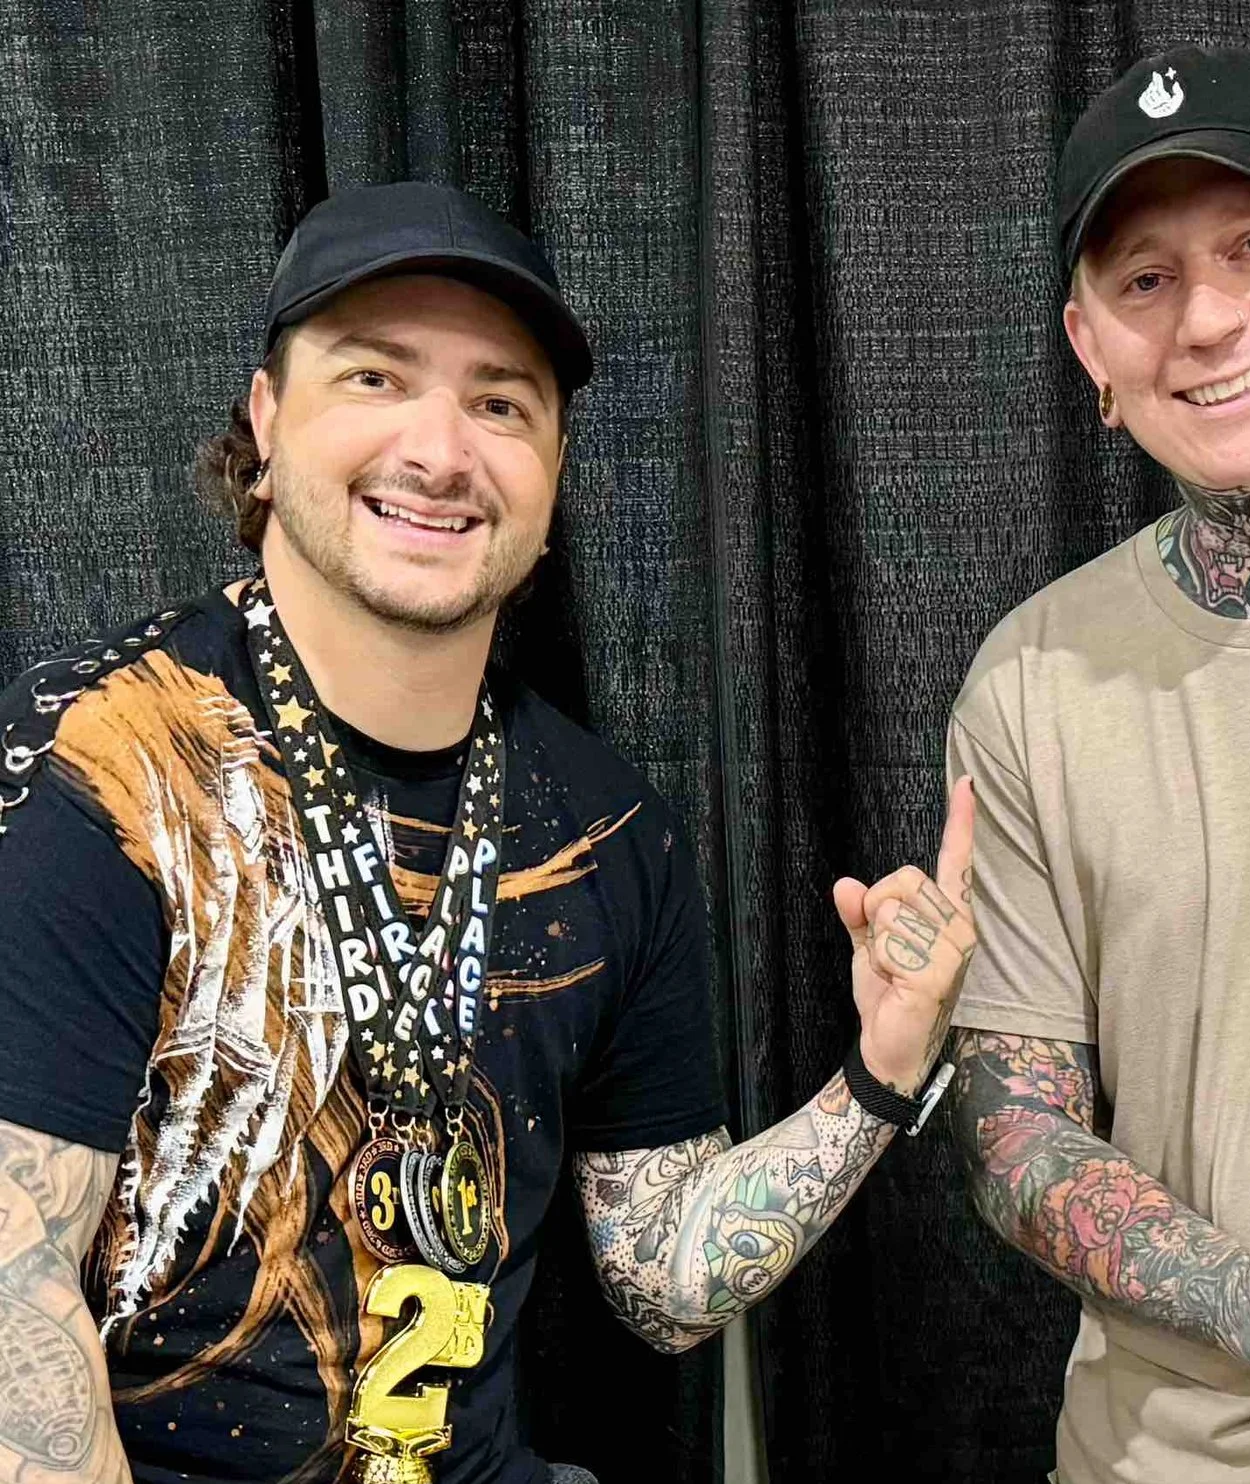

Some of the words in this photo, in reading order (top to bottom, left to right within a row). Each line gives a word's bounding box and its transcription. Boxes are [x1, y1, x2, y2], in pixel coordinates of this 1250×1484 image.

[304, 804, 380, 1021] THIRD
[352, 842, 442, 1035] FIRT
[394, 845, 470, 1041] PLACE
[458, 837, 497, 1031] PLACE
